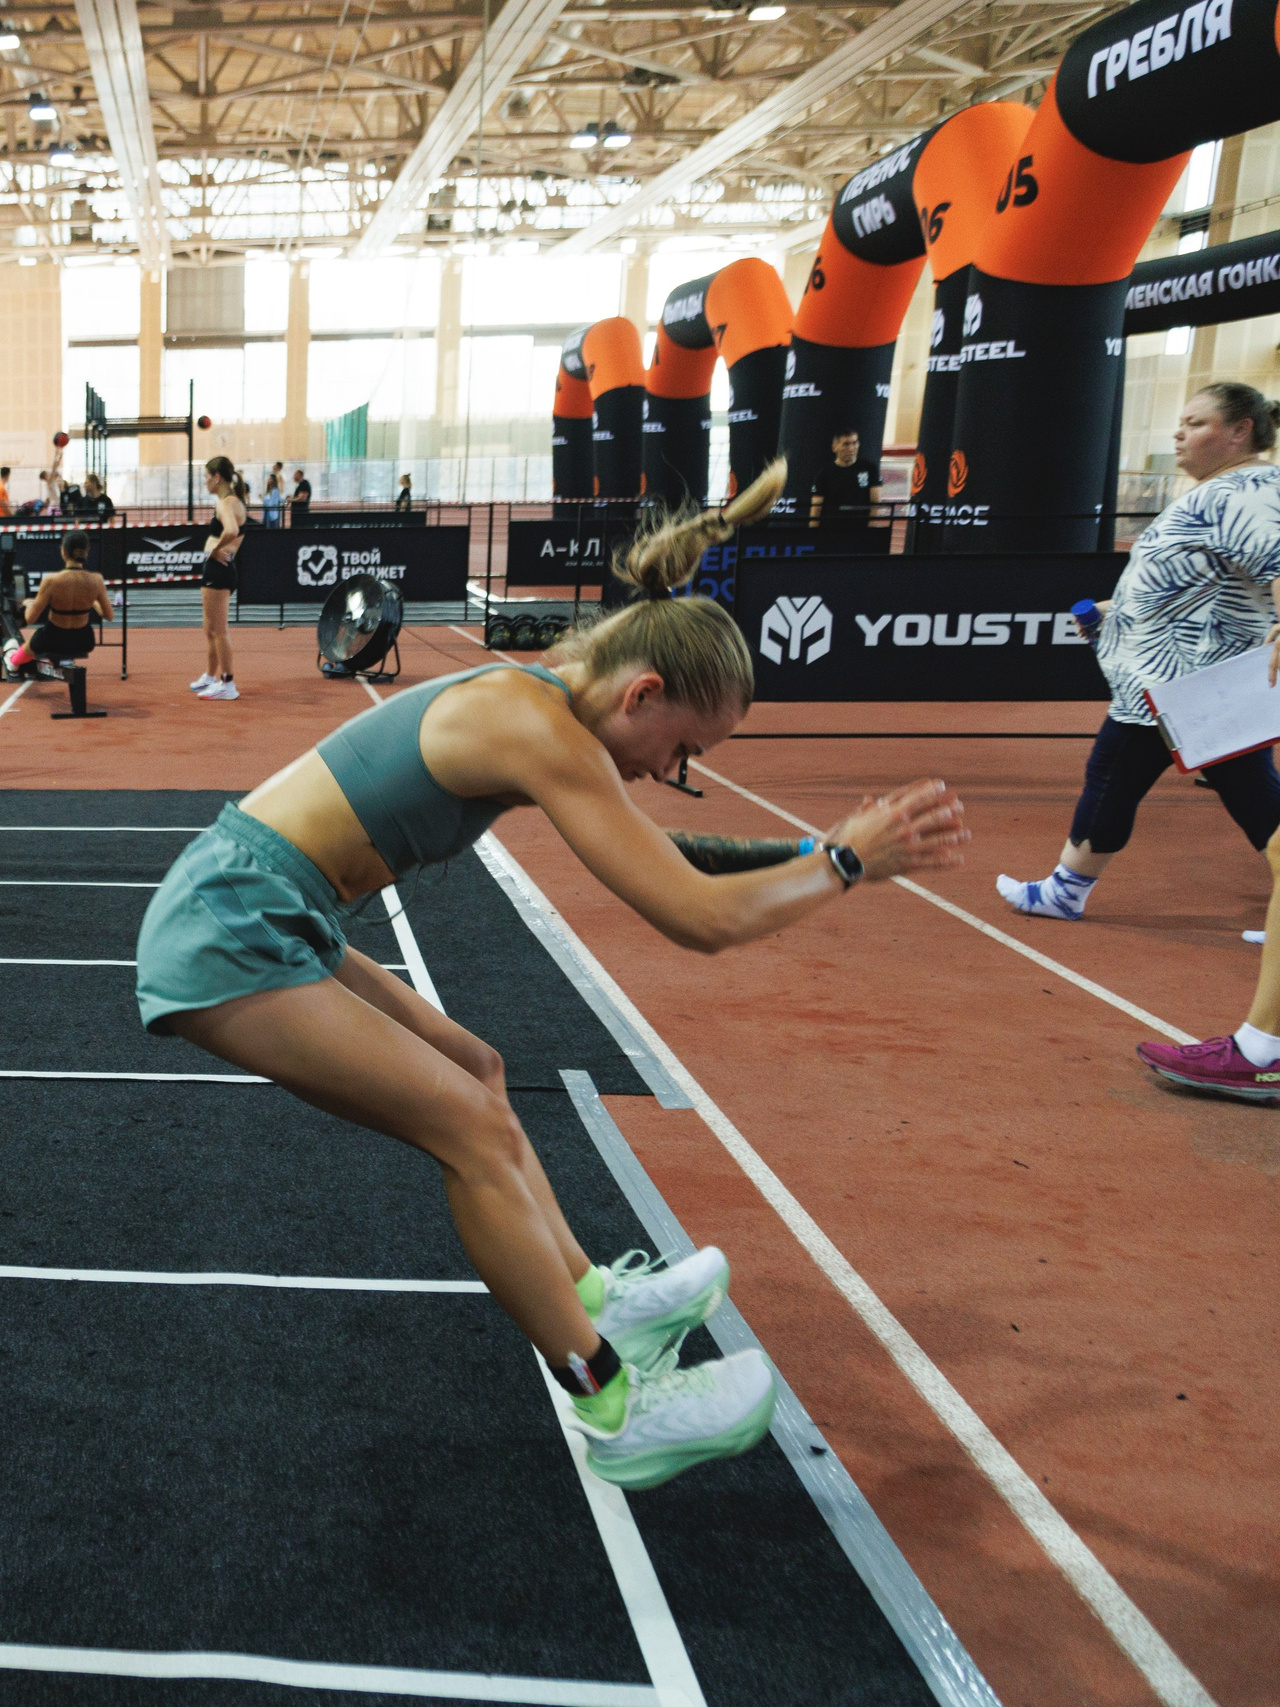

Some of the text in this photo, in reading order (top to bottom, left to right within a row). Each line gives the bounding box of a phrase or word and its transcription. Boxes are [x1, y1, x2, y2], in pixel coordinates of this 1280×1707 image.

[1087, 0, 1234, 99] ГРЕБЛЯ
[851, 192, 897, 239] ГИРЬ
[126, 552, 207, 565] RECORD
[341, 547, 382, 566] ТВОЙ
[167, 564, 193, 572] RADIO
[341, 565, 407, 581] БЮДЖЕТ
